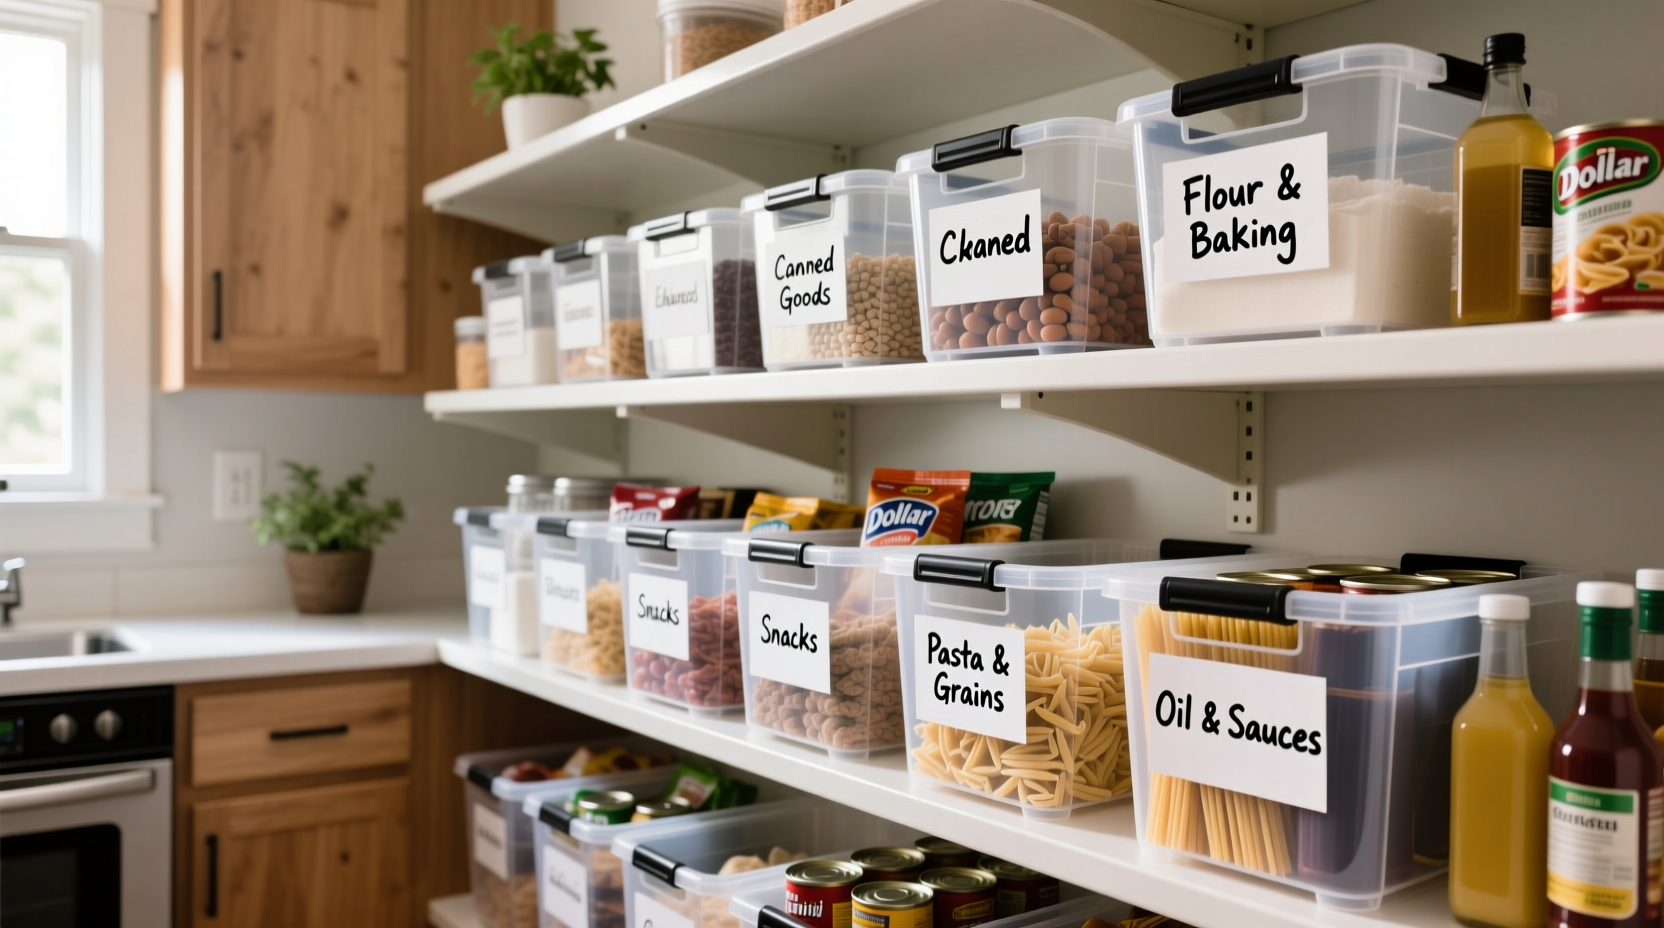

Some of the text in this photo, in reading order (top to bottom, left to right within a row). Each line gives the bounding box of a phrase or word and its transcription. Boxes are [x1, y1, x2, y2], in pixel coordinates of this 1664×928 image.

[1182, 163, 1302, 215] Flour &
[1558, 147, 1649, 201] Dollar
[774, 244, 835, 281] Canned
[1189, 216, 1298, 266] Baking
[779, 281, 832, 315] Goods
[866, 502, 933, 535] Dollar
[760, 613, 818, 654] Snacks
[927, 631, 1010, 677] Pasta &
[933, 671, 1005, 713] Grains
[1155, 689, 1322, 756] Oil & Sauces
